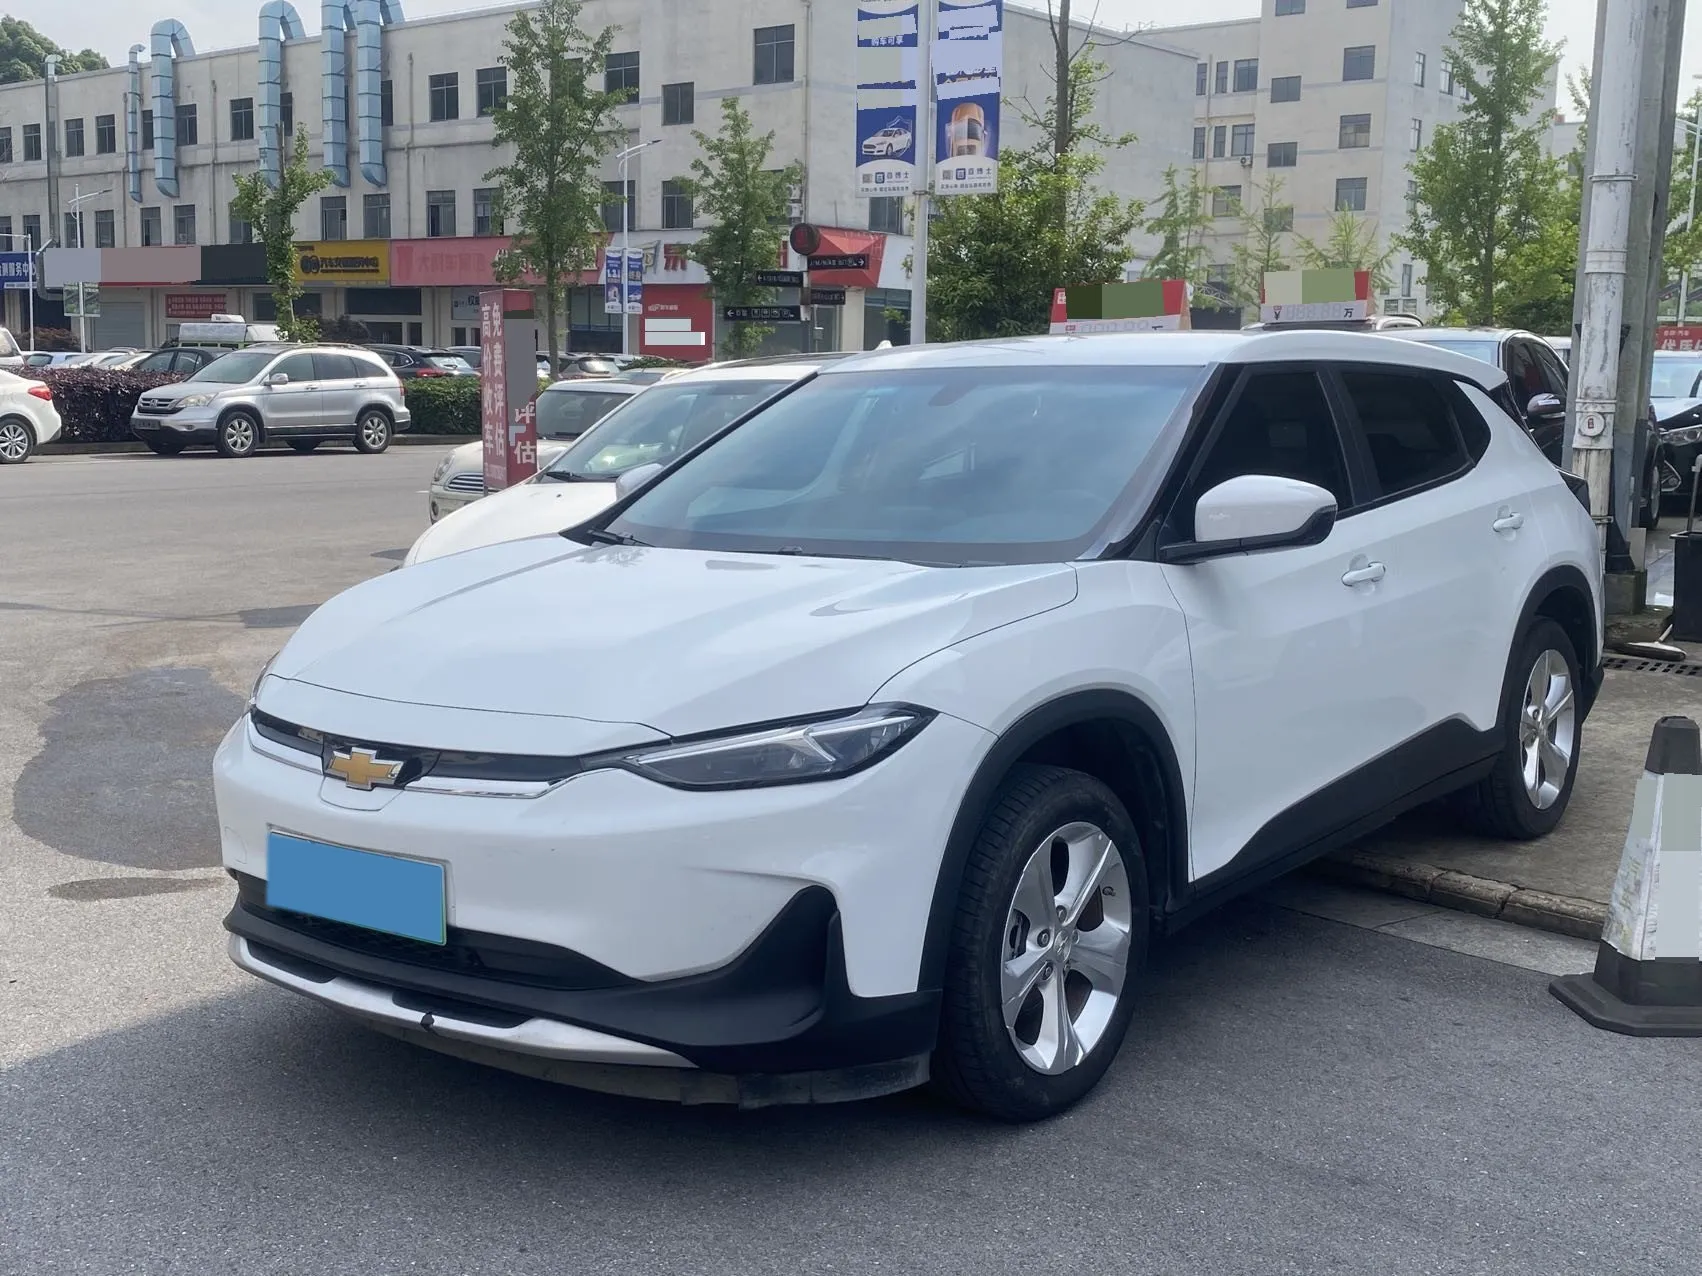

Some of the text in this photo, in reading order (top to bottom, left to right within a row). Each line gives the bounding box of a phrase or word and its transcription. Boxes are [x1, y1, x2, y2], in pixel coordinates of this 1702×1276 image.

[1343, 308, 1354, 318] 万
[481, 304, 493, 456] 高价收车
[492, 302, 504, 457] 免费评估
[514, 401, 536, 464] 评估
